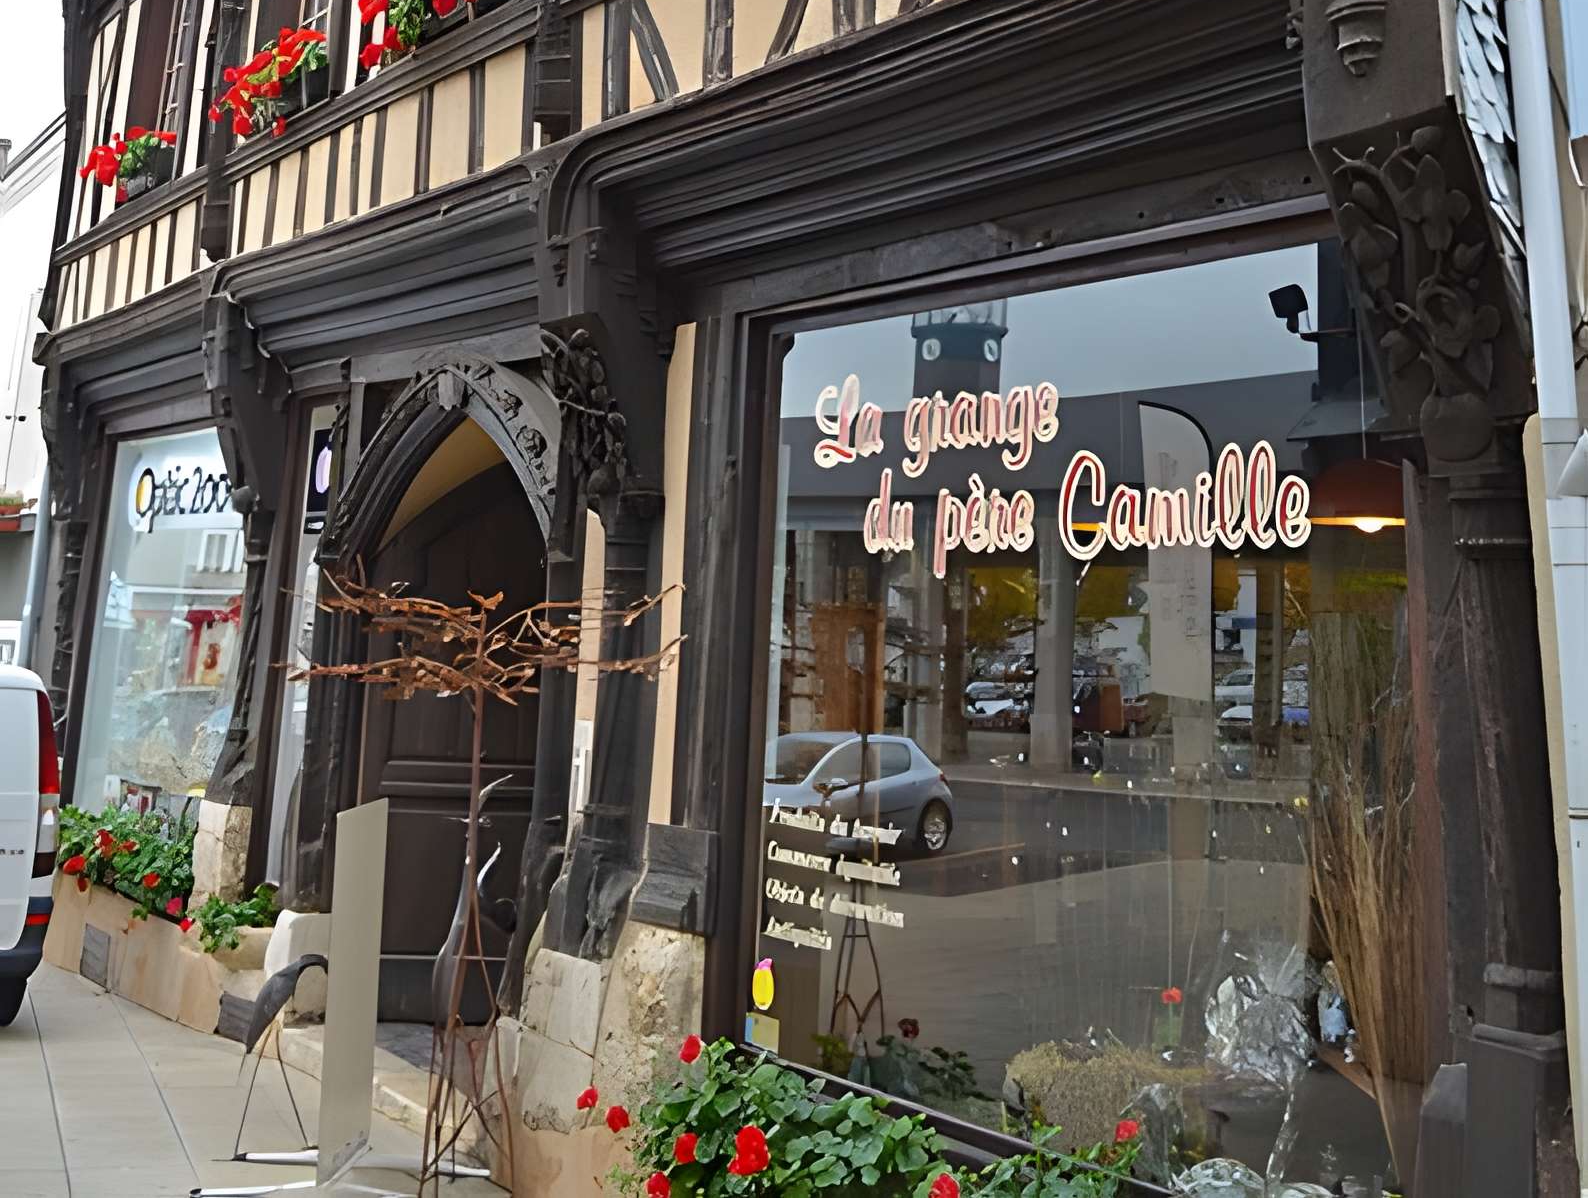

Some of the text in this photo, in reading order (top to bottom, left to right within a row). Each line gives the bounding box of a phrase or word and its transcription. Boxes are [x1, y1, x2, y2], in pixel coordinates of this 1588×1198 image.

[814, 374, 1059, 477] La grange
[864, 440, 1312, 579] du père Camille
